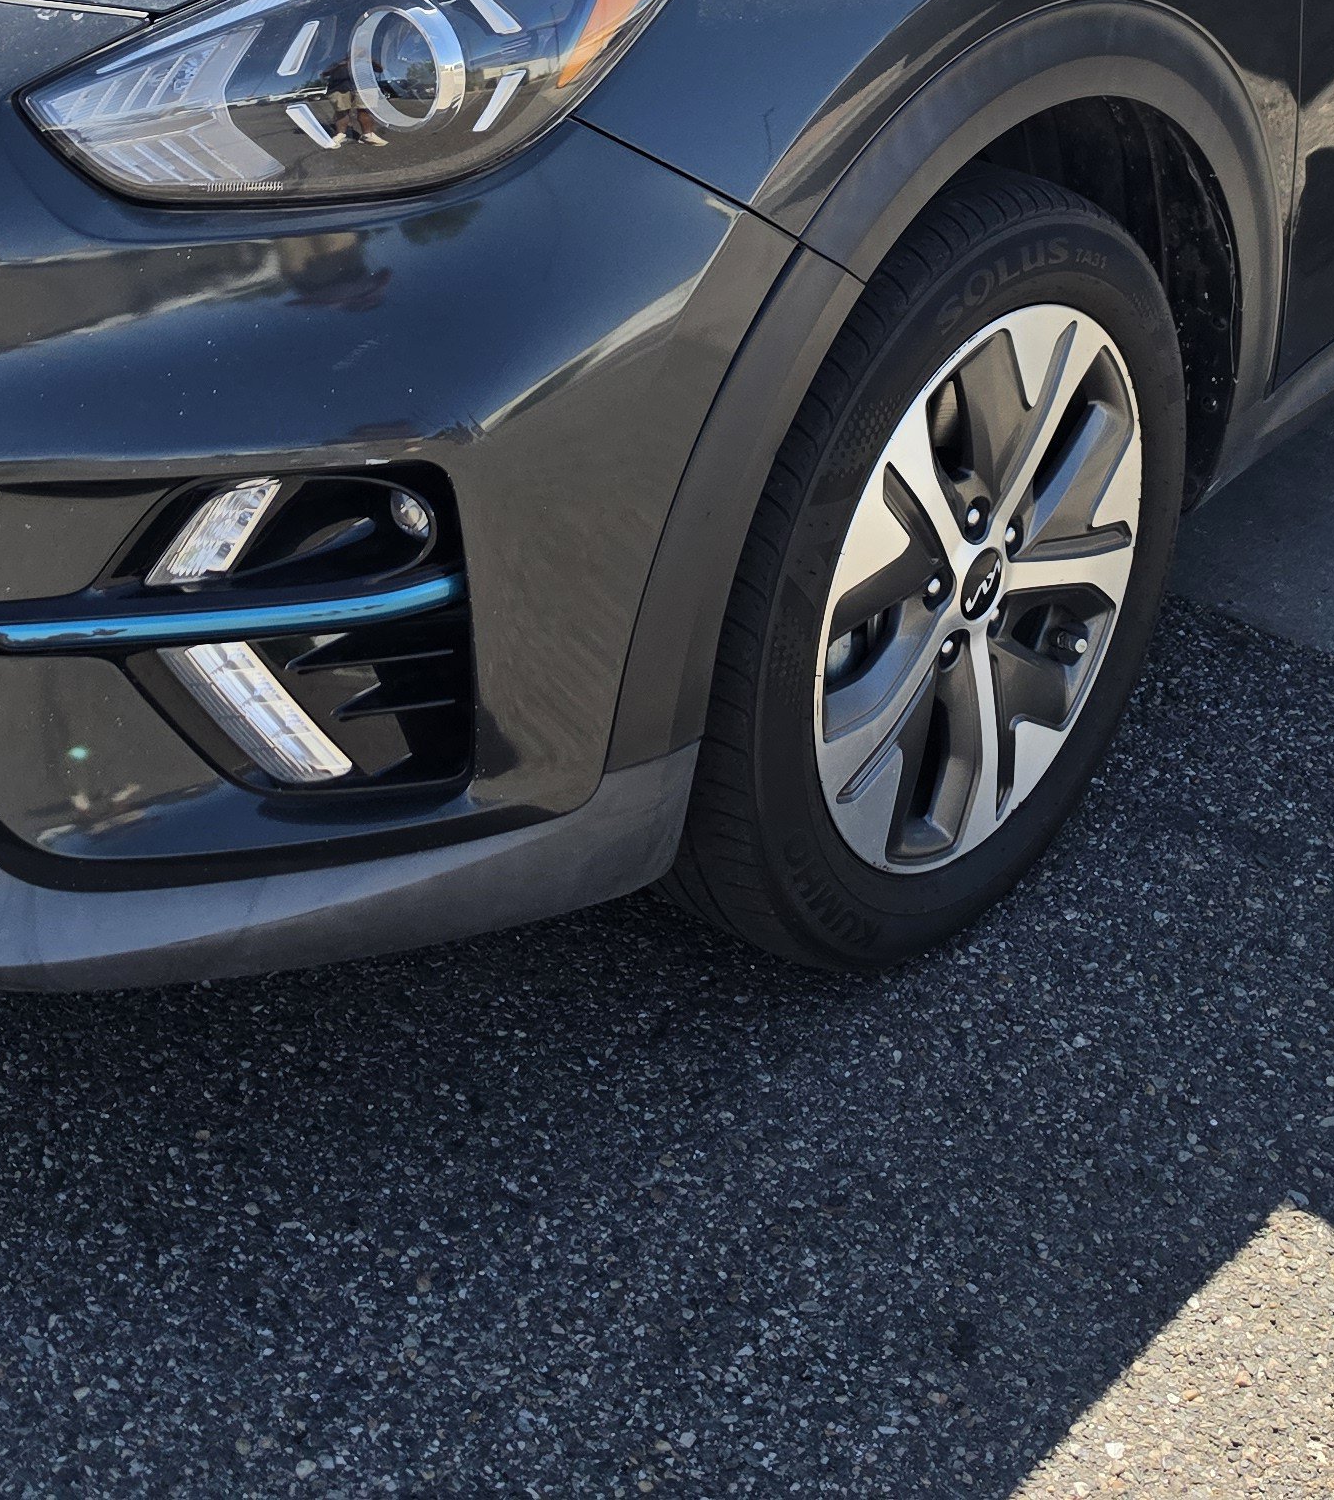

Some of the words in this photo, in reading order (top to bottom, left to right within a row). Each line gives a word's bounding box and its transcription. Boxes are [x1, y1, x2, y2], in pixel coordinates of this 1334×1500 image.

[936, 237, 1070, 336] SOLUS
[1074, 248, 1108, 270] TA31
[783, 829, 880, 949] KUMHO
